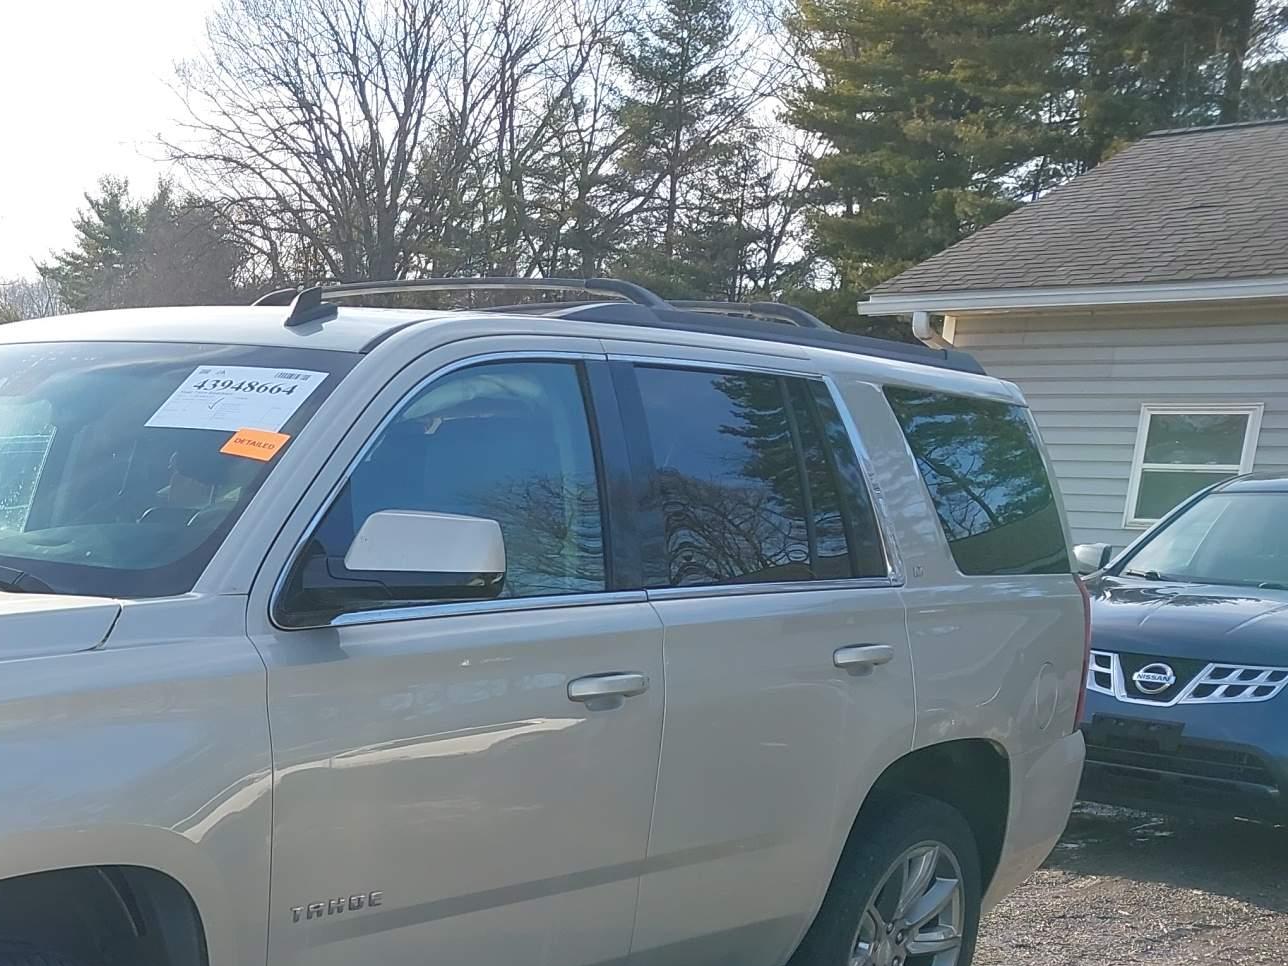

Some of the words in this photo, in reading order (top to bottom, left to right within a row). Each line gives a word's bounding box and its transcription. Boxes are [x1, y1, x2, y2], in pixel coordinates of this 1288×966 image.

[193, 378, 298, 395] 43948664
[233, 437, 276, 450] DETAILED
[1136, 674, 1171, 682] NISSAN
[290, 890, 384, 923] TAHOE
